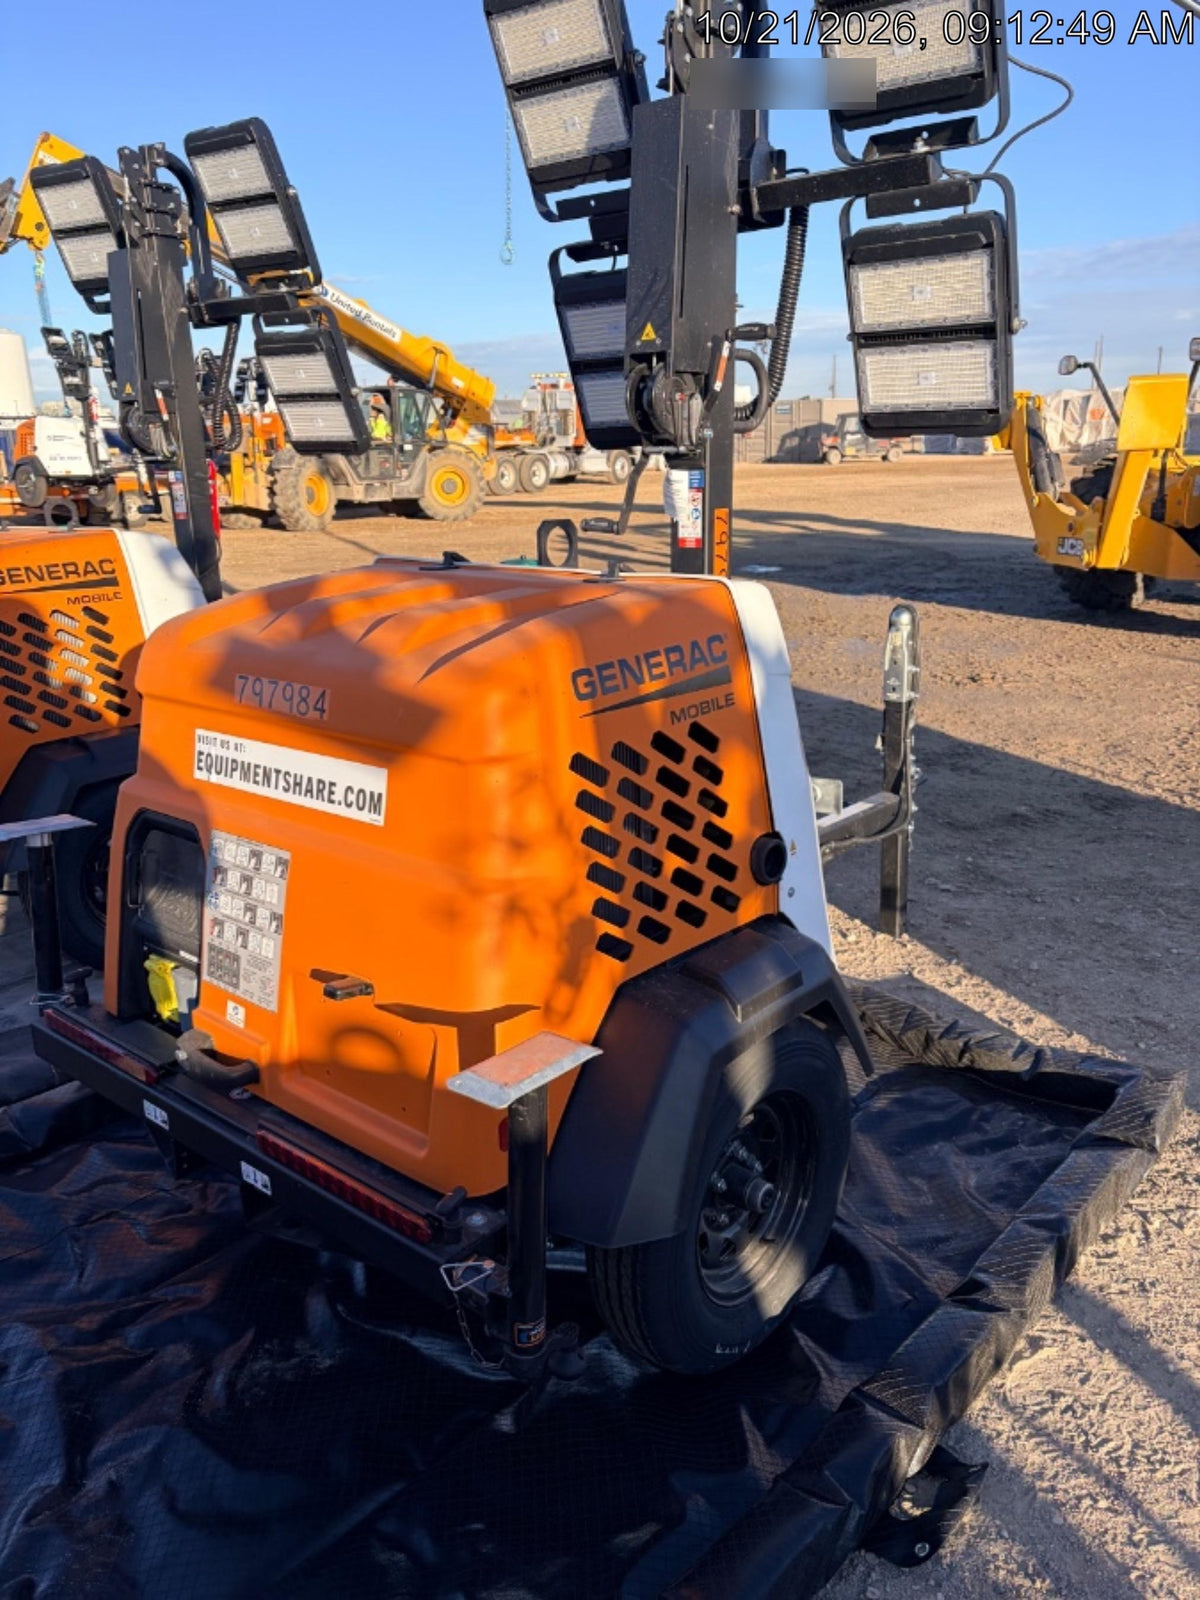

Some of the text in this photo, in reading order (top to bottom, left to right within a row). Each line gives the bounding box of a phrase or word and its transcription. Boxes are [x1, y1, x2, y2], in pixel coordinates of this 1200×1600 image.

[571, 634, 728, 701] GENERAC
[237, 674, 328, 719] 797984
[670, 692, 736, 725] MOBILE
[196, 749, 384, 817] EQUIPMENTSHARE.COM
